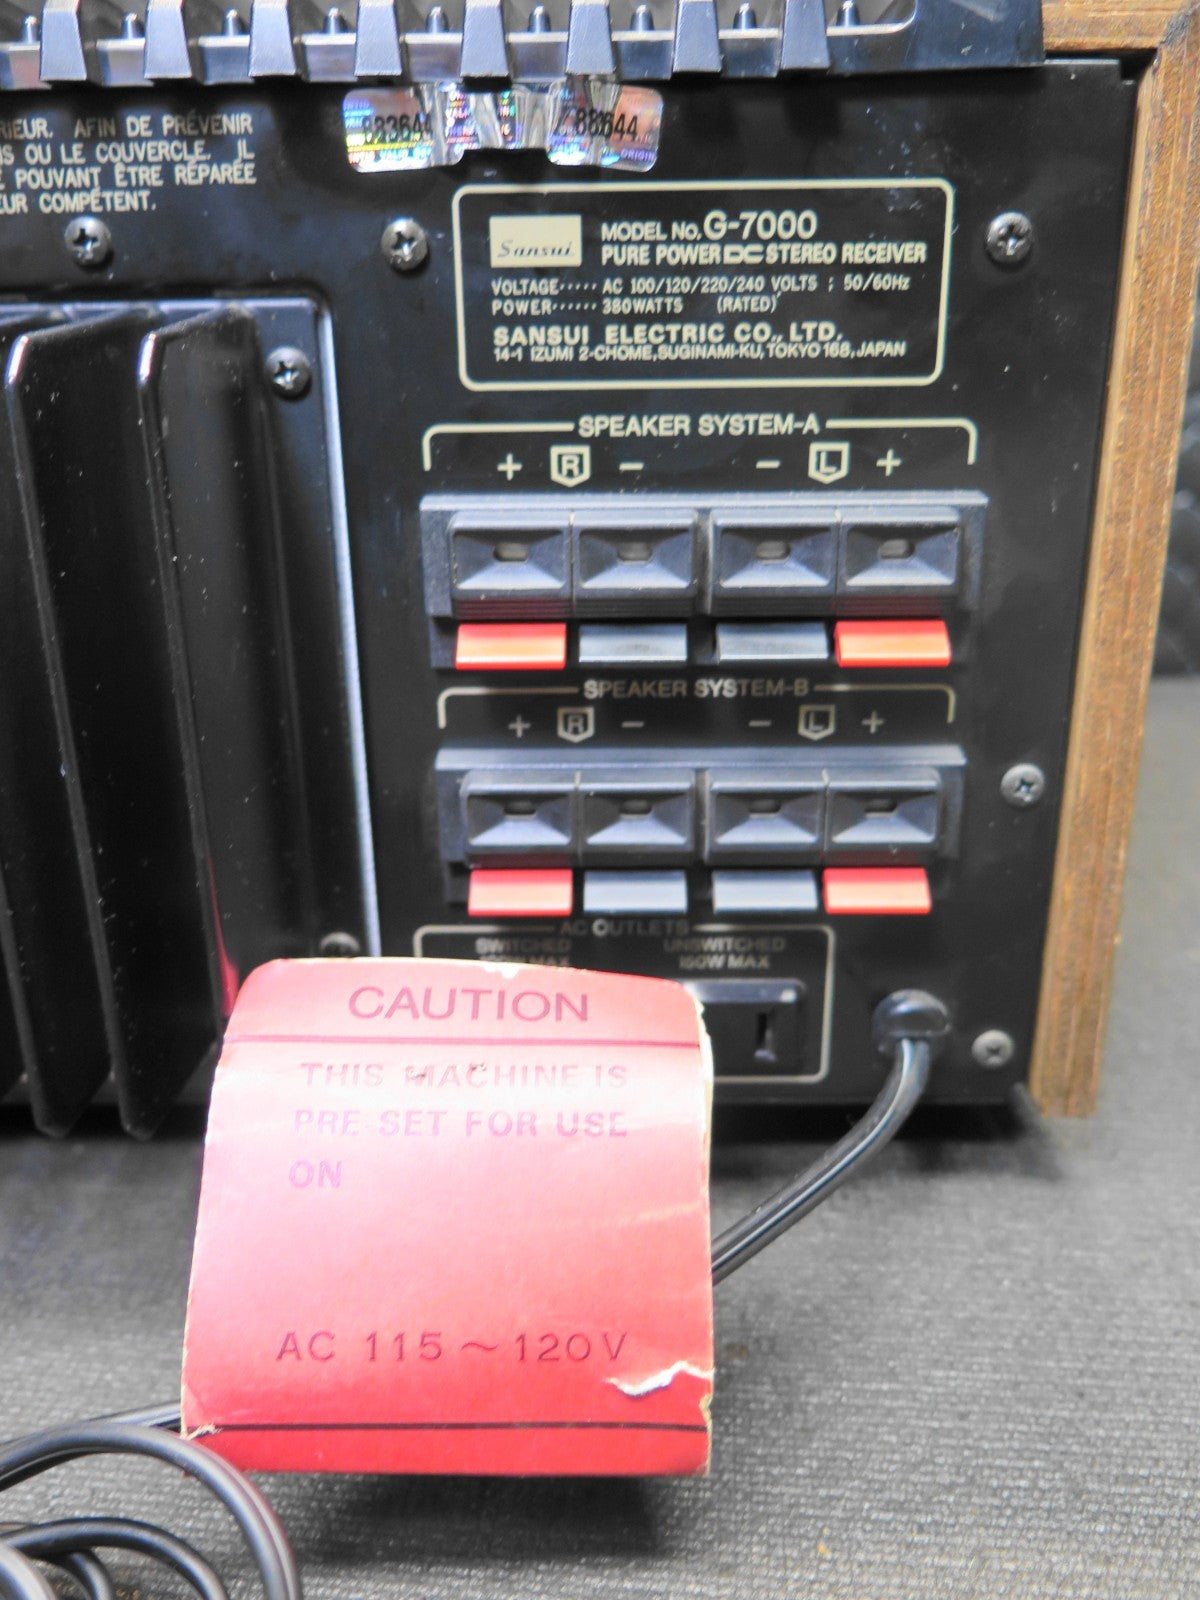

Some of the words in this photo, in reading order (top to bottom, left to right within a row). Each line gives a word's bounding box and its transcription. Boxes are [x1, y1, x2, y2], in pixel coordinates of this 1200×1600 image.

[74, 117, 116, 138] AFIN
[126, 115, 151, 136] DE
[162, 109, 253, 136] PRÉVENIR
[0, 143, 14, 166] S
[25, 143, 51, 165] OU
[60, 142, 86, 164] LE
[236, 138, 255, 160] IL
[15, 166, 101, 190] POUVANT
[114, 160, 163, 187] ÊTRE
[175, 158, 257, 185] RÉPARÉE
[601, 221, 667, 242] MODEL
[703, 209, 818, 241] G-7000
[497, 238, 575, 259] Sansui
[601, 244, 650, 267] PURE
[655, 243, 721, 266] POWER
[765, 242, 837, 264] STEREO
[841, 241, 928, 264] RECEIVER
[602, 277, 623, 294] AC
[630, 273, 765, 295] 100/120/220/240
[771, 274, 818, 293] VOLTS
[843, 272, 911, 292] 50/60Hz
[716, 295, 778, 315] (RATED)
[493, 325, 589, 347] SANSUI
[604, 322, 725, 345] ELECTRIC
[530, 345, 574, 362] IZUMI
[578, 414, 691, 438] SPEAKER
[698, 412, 820, 436] SYSTEM-A
[583, 680, 688, 699] SPEAKER
[694, 678, 809, 698] SYSTEM-B
[349, 986, 589, 1022] CAUTION
[301, 1062, 384, 1088] THIS
[405, 1062, 584, 1088] MACHINE
[595, 1063, 628, 1088] IS
[466, 1111, 538, 1138] FOR
[556, 1112, 628, 1138] USE
[288, 1160, 342, 1188] ON
[275, 1331, 335, 1361] AC
[366, 1331, 443, 1362] 115
